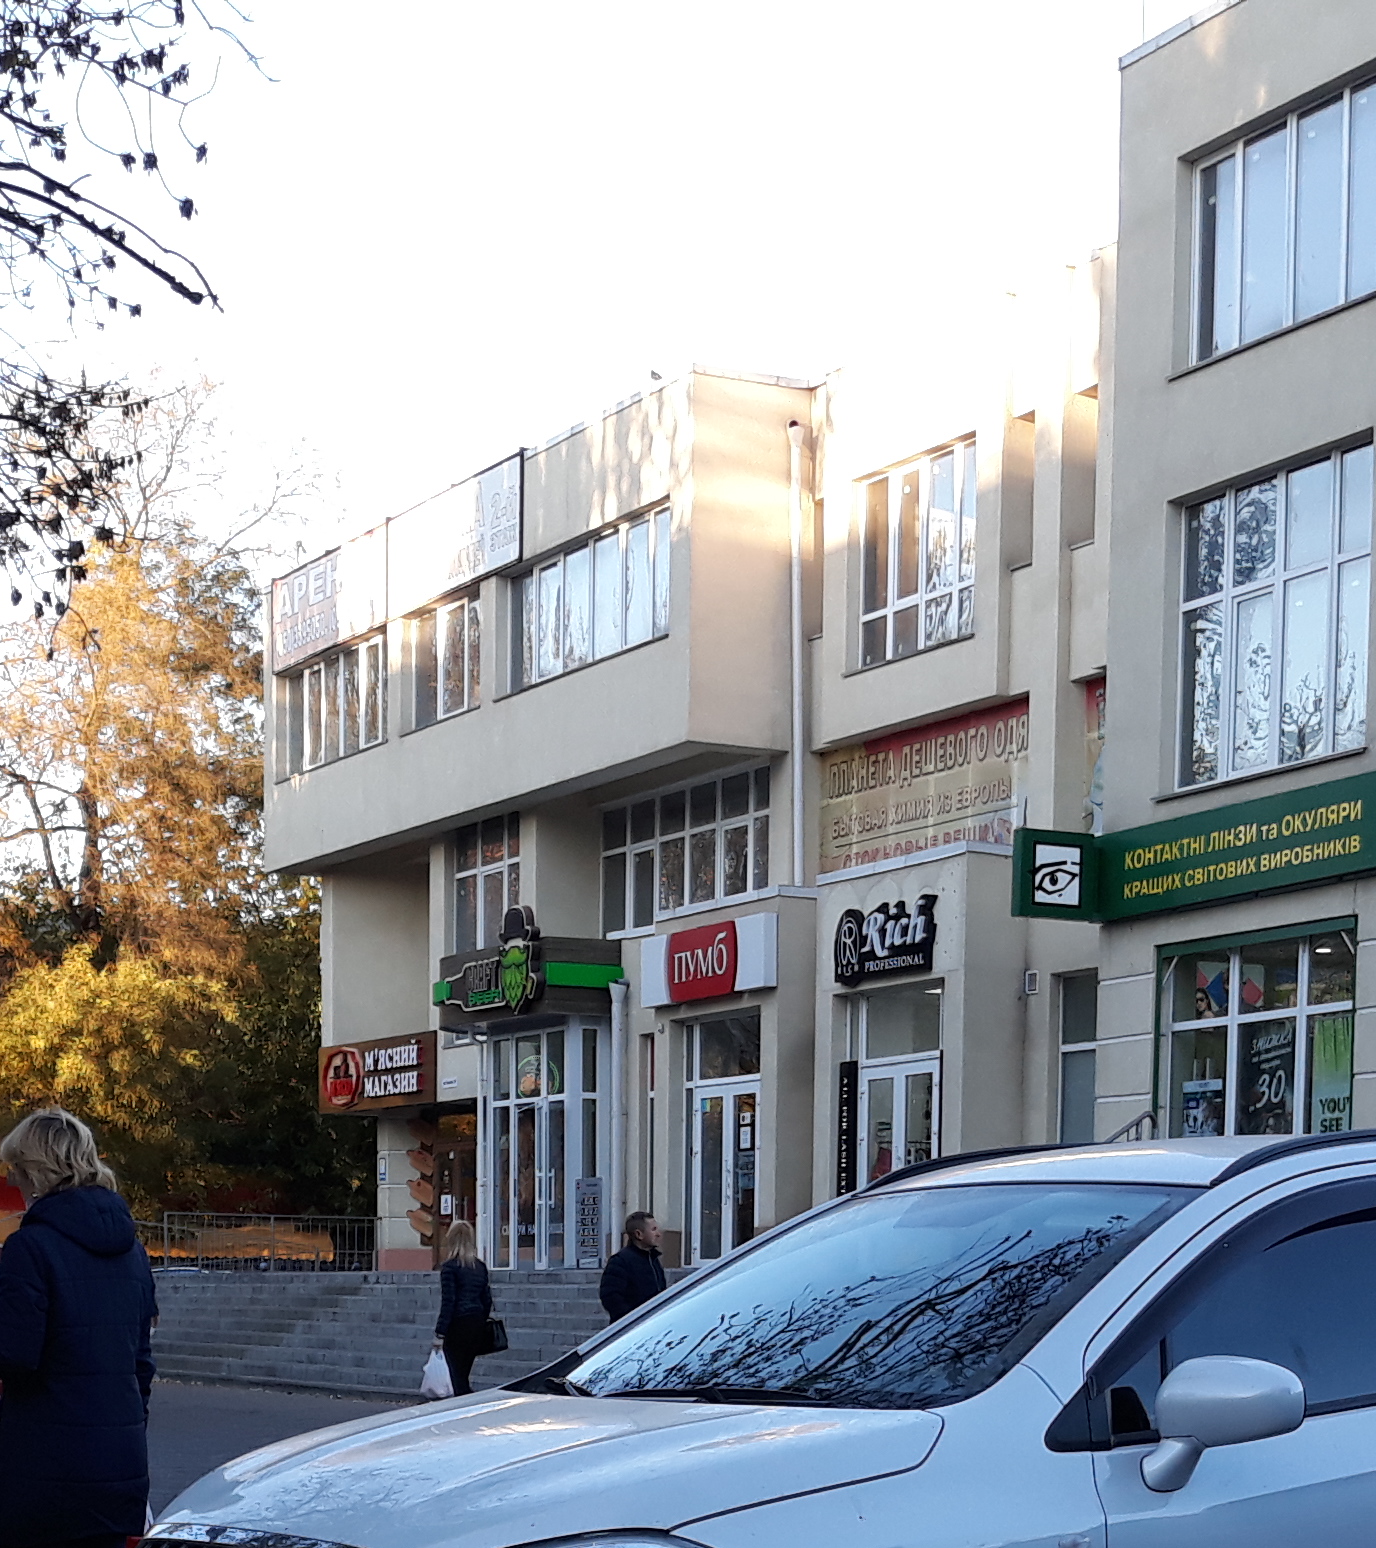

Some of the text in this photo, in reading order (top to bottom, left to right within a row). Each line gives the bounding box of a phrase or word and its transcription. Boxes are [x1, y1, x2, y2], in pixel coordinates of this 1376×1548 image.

[829, 750, 895, 799] ПЛАНЕТА
[899, 725, 988, 788] ДЕШЕВОГО
[831, 777, 1011, 840] БЫТОВАЯ ХИМИЯ ИЗ ЕВРОПЫ
[1124, 799, 1363, 870] КОНТАКТНІ ЛІНЗИ та ОКУЛЯРИ
[1124, 835, 1361, 899] КРАЩИХ СВІТОВИХ ВИРОБНИКІВ
[860, 899, 927, 957] Rich
[864, 953, 924, 973] PROFESSIONAL
[364, 1039, 418, 1071] М'ЯСНИЙ
[364, 1071, 418, 1098] МАГАЗИН
